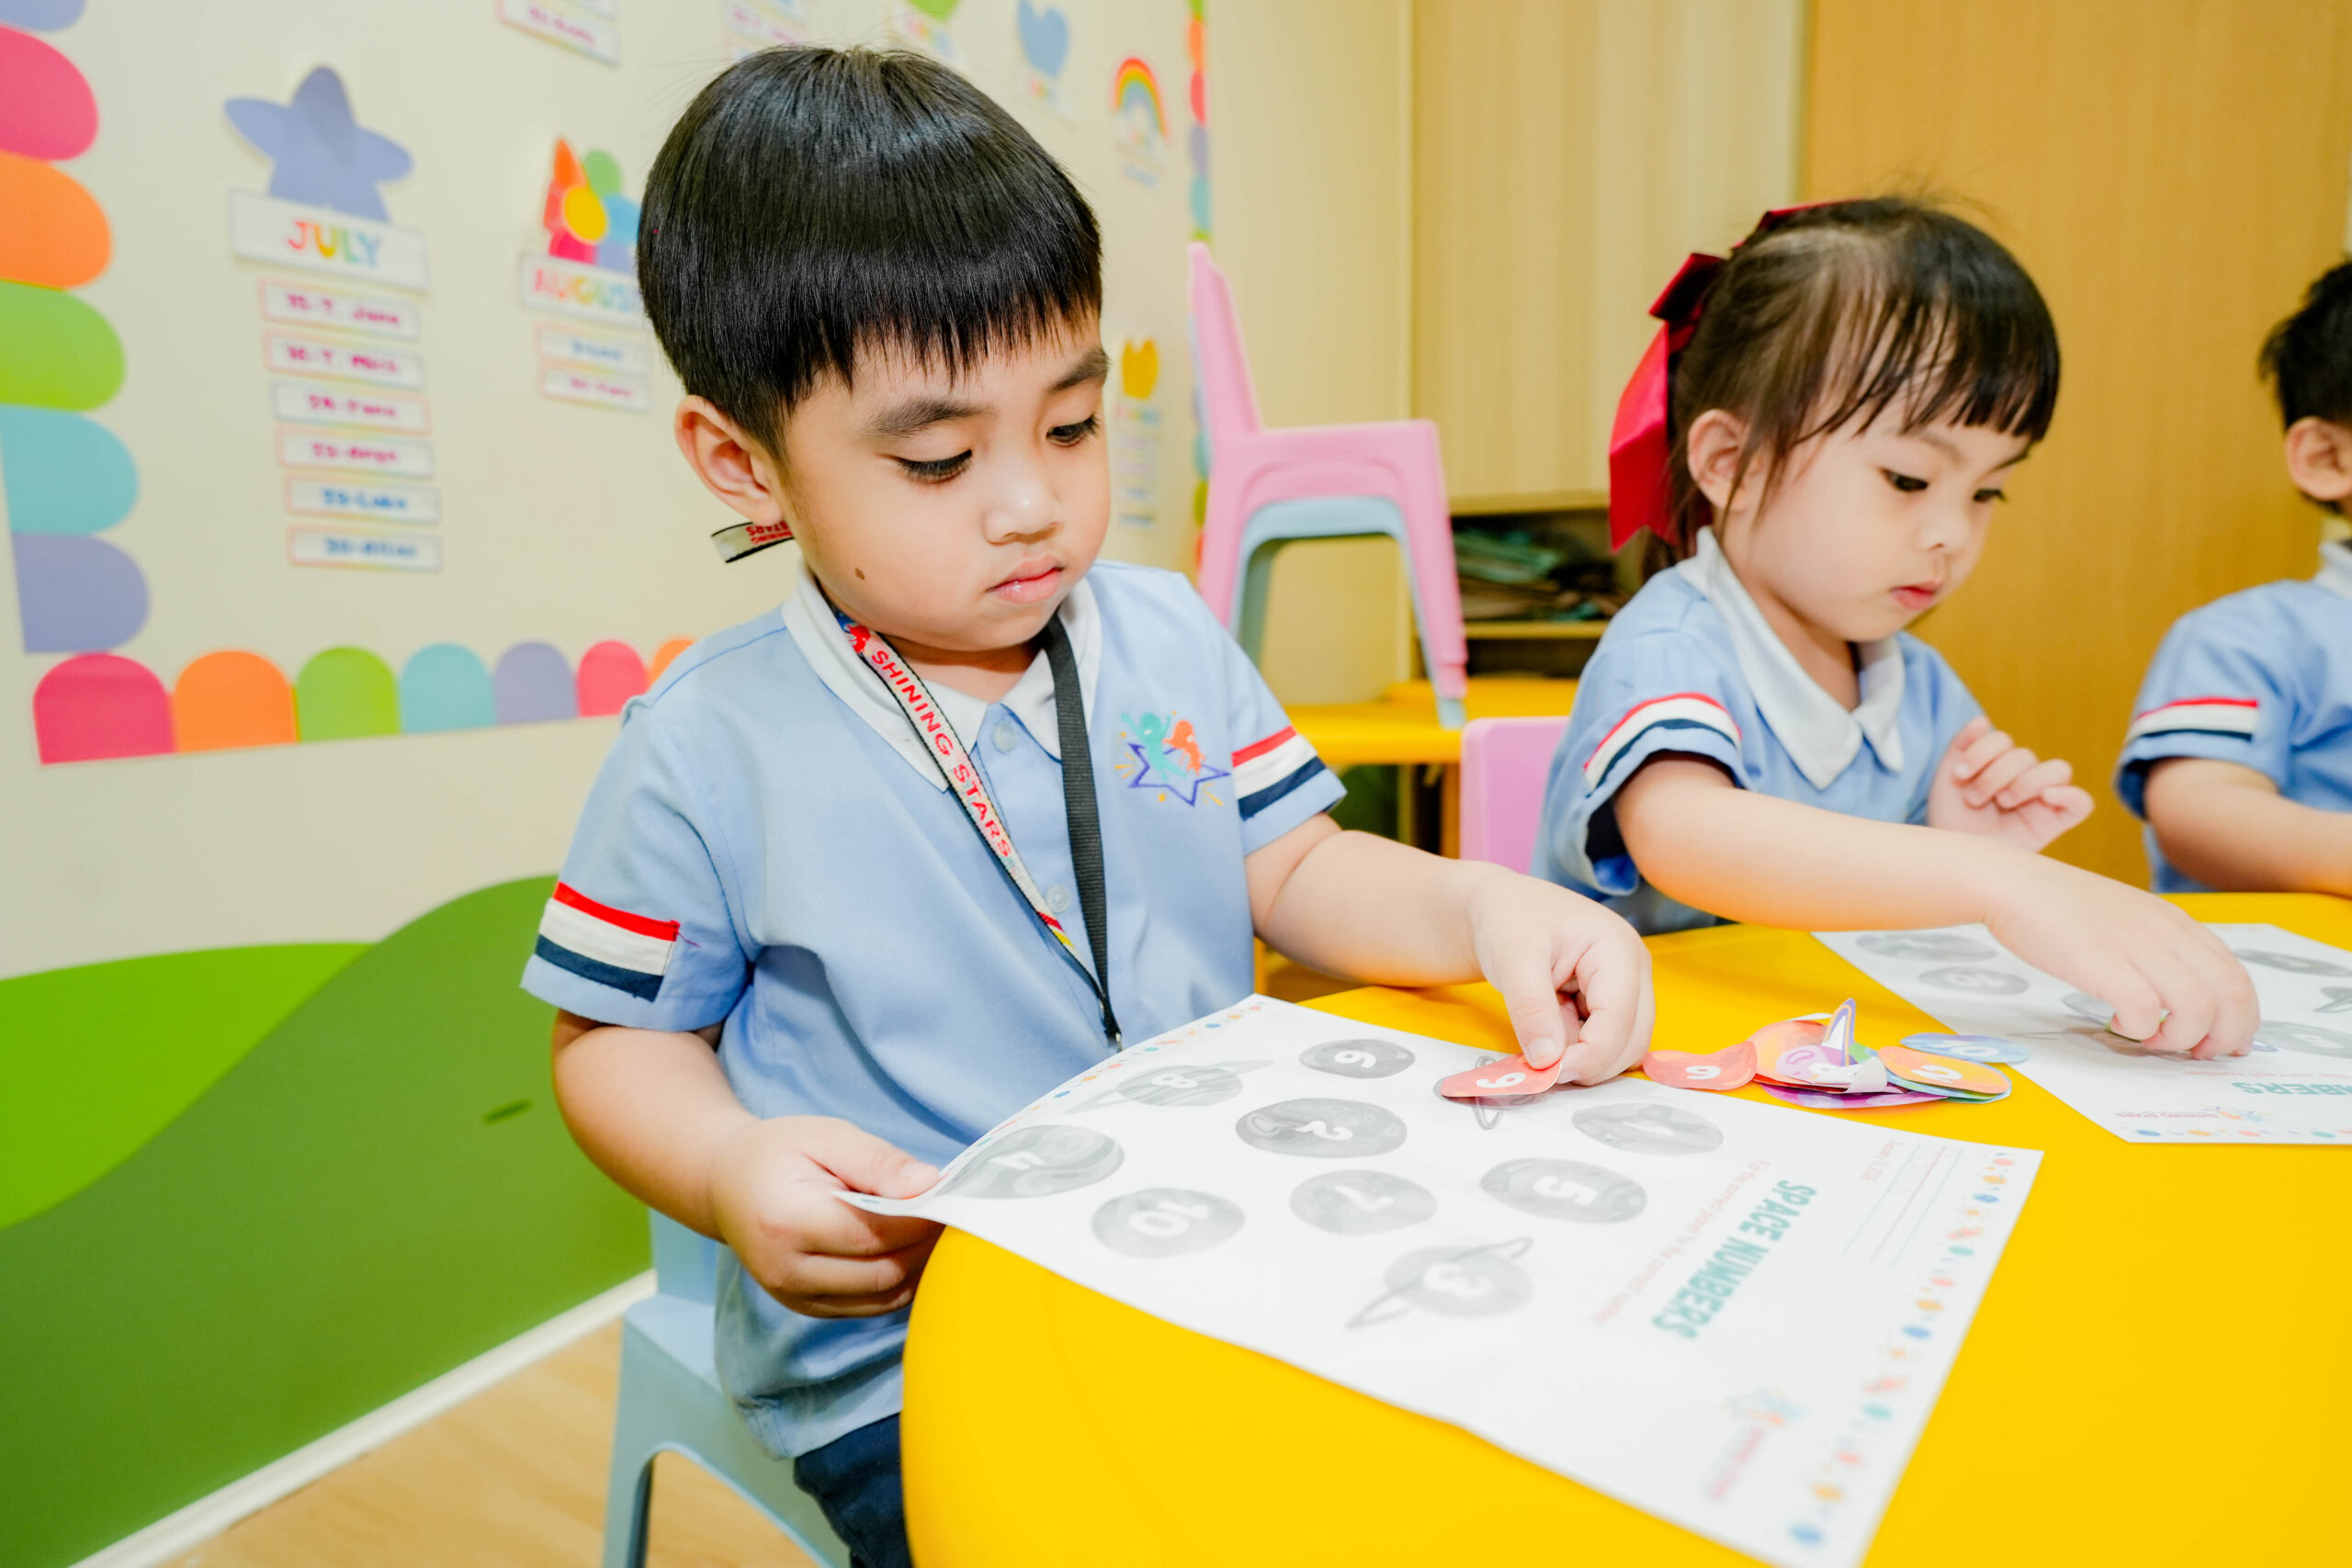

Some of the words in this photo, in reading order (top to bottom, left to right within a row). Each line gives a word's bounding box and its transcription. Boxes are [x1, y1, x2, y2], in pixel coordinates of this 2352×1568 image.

[287, 219, 382, 268] JULY
[872, 649, 955, 756] SHINING
[953, 763, 1012, 857] STARS
[1151, 1072, 1198, 1089] 8
[1295, 1119, 1353, 1141] 2
[1335, 1185, 1395, 1212] 7
[1533, 1175, 1599, 1206] 5
[1128, 1201, 1209, 1237] 10
[1738, 1179, 1817, 1241] SPACE
[1421, 1262, 1495, 1297] 3
[1652, 1236, 1770, 1338] NUMBERS
